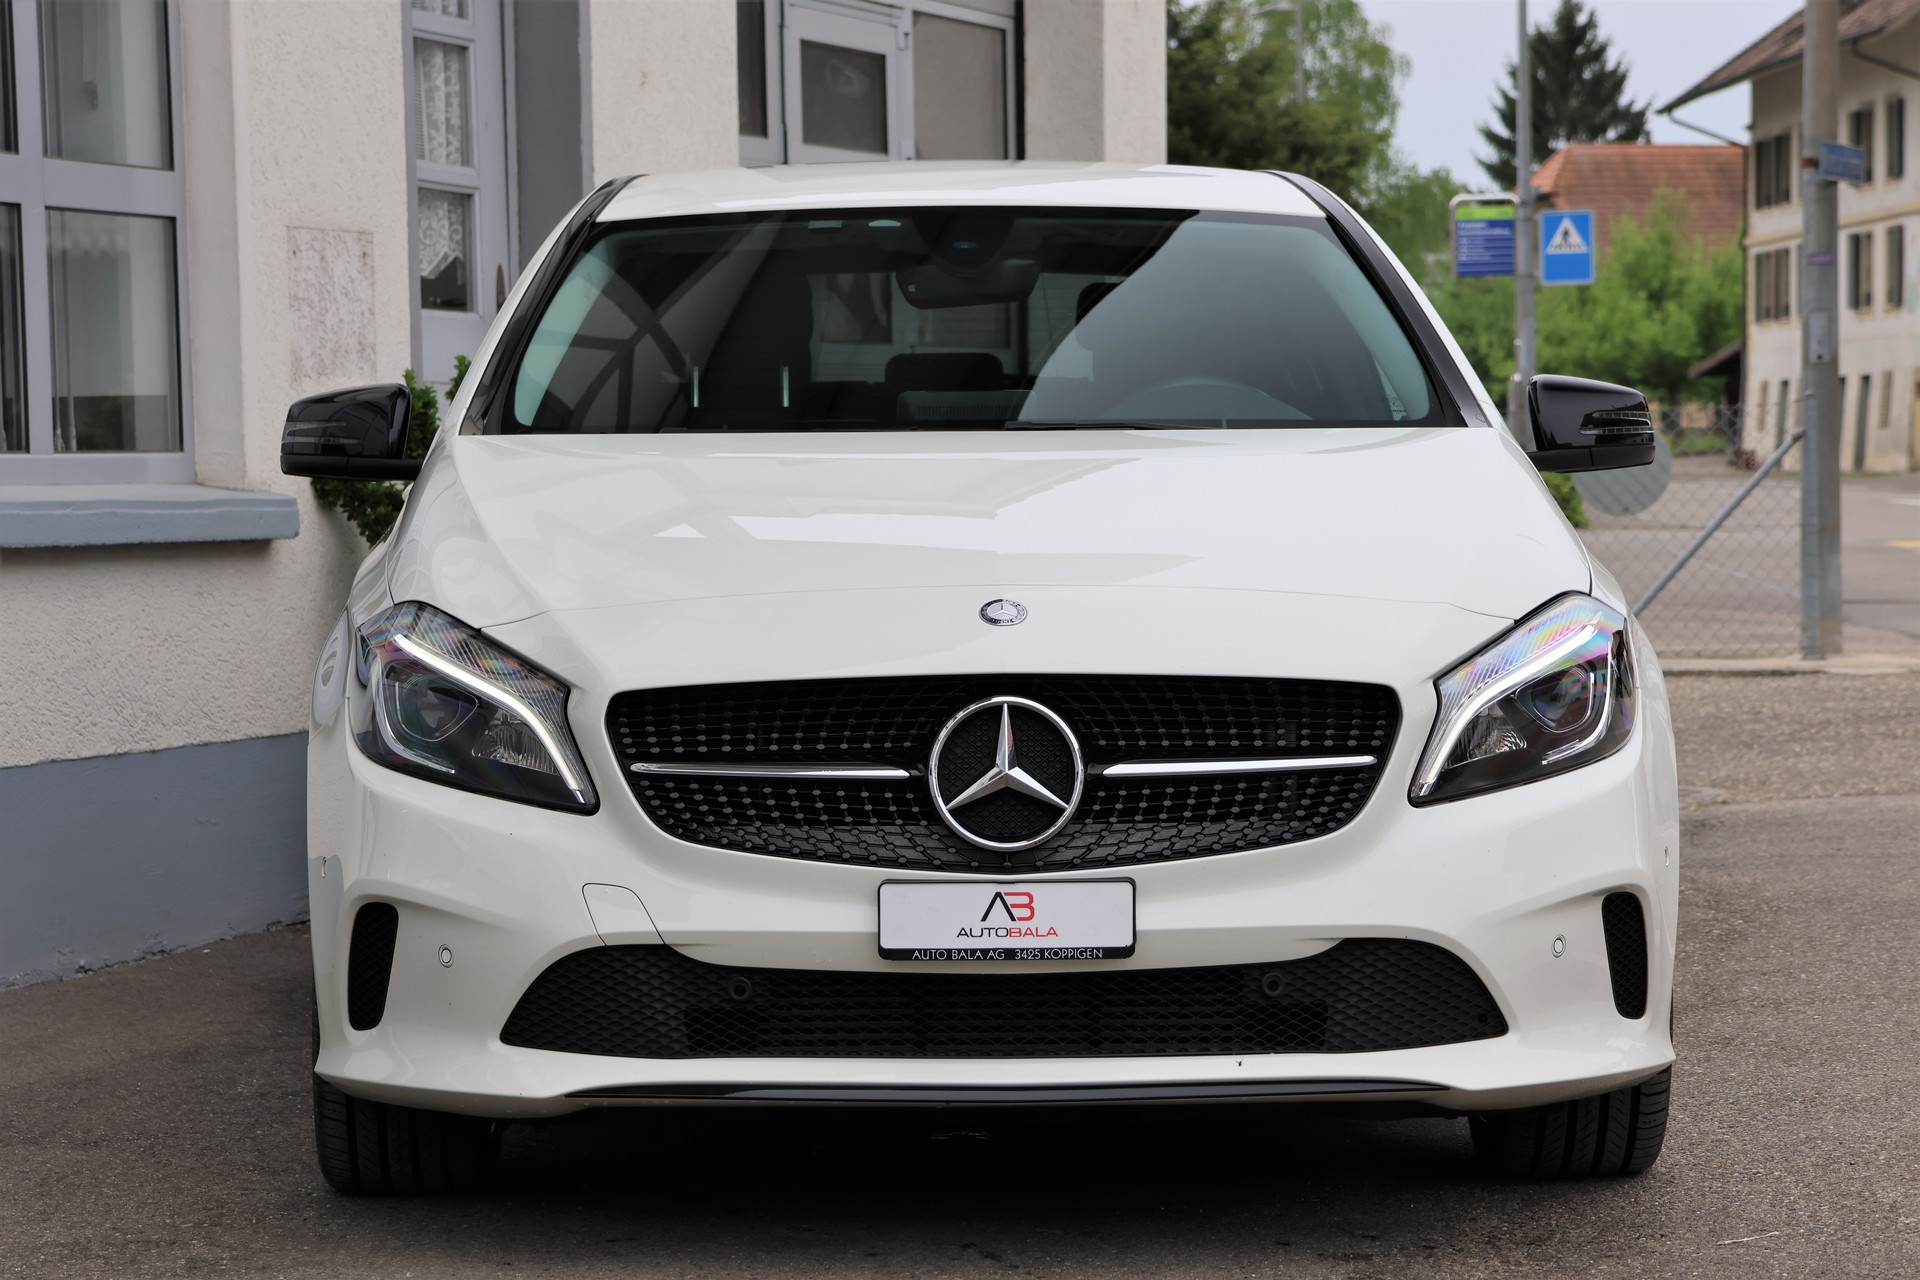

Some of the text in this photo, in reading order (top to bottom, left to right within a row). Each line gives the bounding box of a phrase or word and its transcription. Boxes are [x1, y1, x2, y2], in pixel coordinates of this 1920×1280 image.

[980, 891, 1035, 922] AB
[956, 927, 1058, 938] AUTOBALA
[912, 948, 1103, 960] AUTO BALA AG 3425 KOPPIGEN
